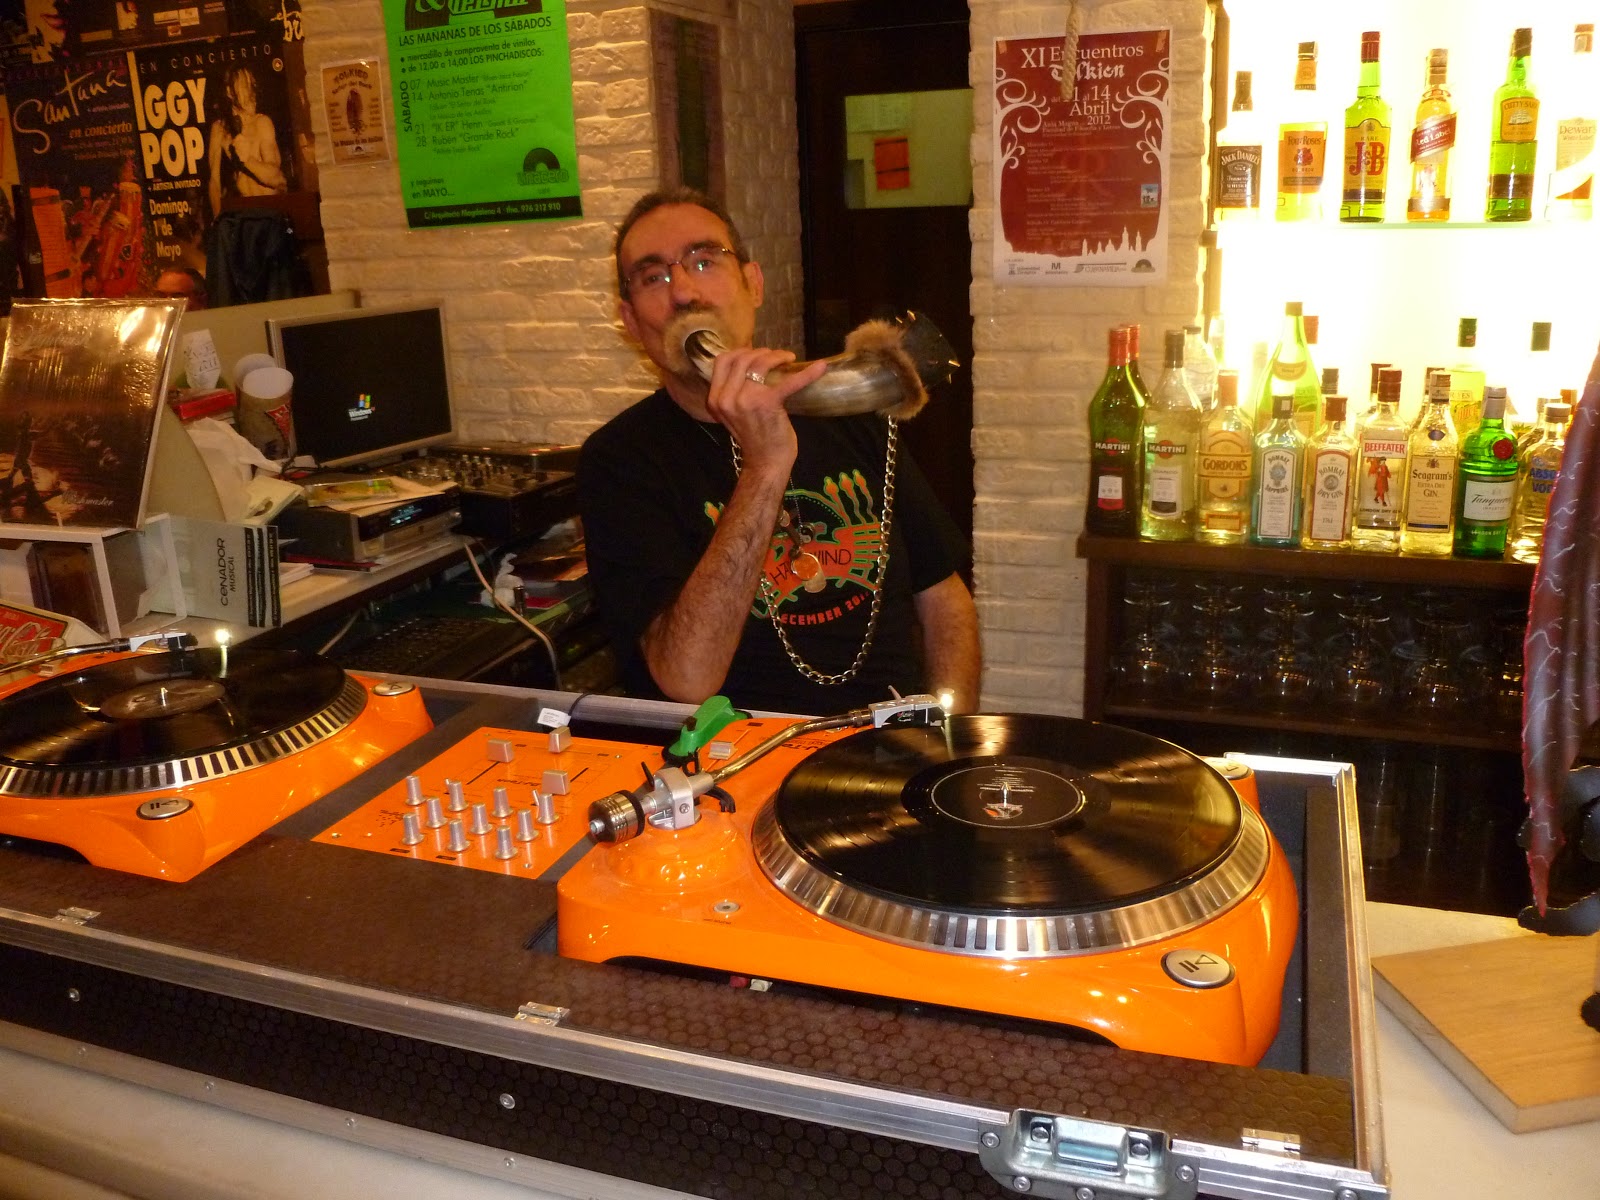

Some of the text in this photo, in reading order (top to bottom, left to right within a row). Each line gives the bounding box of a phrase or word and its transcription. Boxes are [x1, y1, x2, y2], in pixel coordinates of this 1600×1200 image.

[399, 35, 415, 47] LAS
[468, 25, 481, 37] DE
[483, 23, 502, 35] LOS
[504, 15, 552, 33] SÁBADOS
[407, 49, 443, 61] mercadillo
[501, 40, 511, 49] de
[512, 37, 536, 48] vinilos
[139, 61, 158, 74] EN
[170, 44, 272, 69] CONCIERTO
[408, 64, 417, 73] de
[469, 55, 484, 65] LOS
[1021, 47, 1046, 68] XI
[1049, 61, 1125, 81] Tlkien
[127, 51, 206, 131] IGGY
[409, 78, 421, 91] 07
[411, 92, 423, 102] 14
[1092, 85, 1111, 101] 14
[13, 69, 127, 154] Santana
[399, 80, 413, 133] SABADO
[1068, 100, 1111, 117] Abril
[1087, 115, 1112, 126] 2012
[84, 121, 133, 137] concierto
[415, 135, 427, 148] 28
[140, 126, 206, 179] POP
[1221, 153, 1237, 166] JACK
[412, 191, 422, 199] en
[161, 217, 173, 236] de
[156, 242, 181, 262] Mayo
[1095, 442, 1130, 451] MARTINI
[1149, 444, 1185, 453] MARTINI
[1364, 442, 1405, 454] BEEFEATER
[1268, 454, 1290, 464] BOMBAY
[1318, 466, 1345, 477] BOMBAY
[1412, 468, 1453, 482] Seagram's
[1317, 489, 1330, 499] DRY
[227, 556, 236, 593] MUSICAL
[780, 606, 843, 626] ECEMBER
